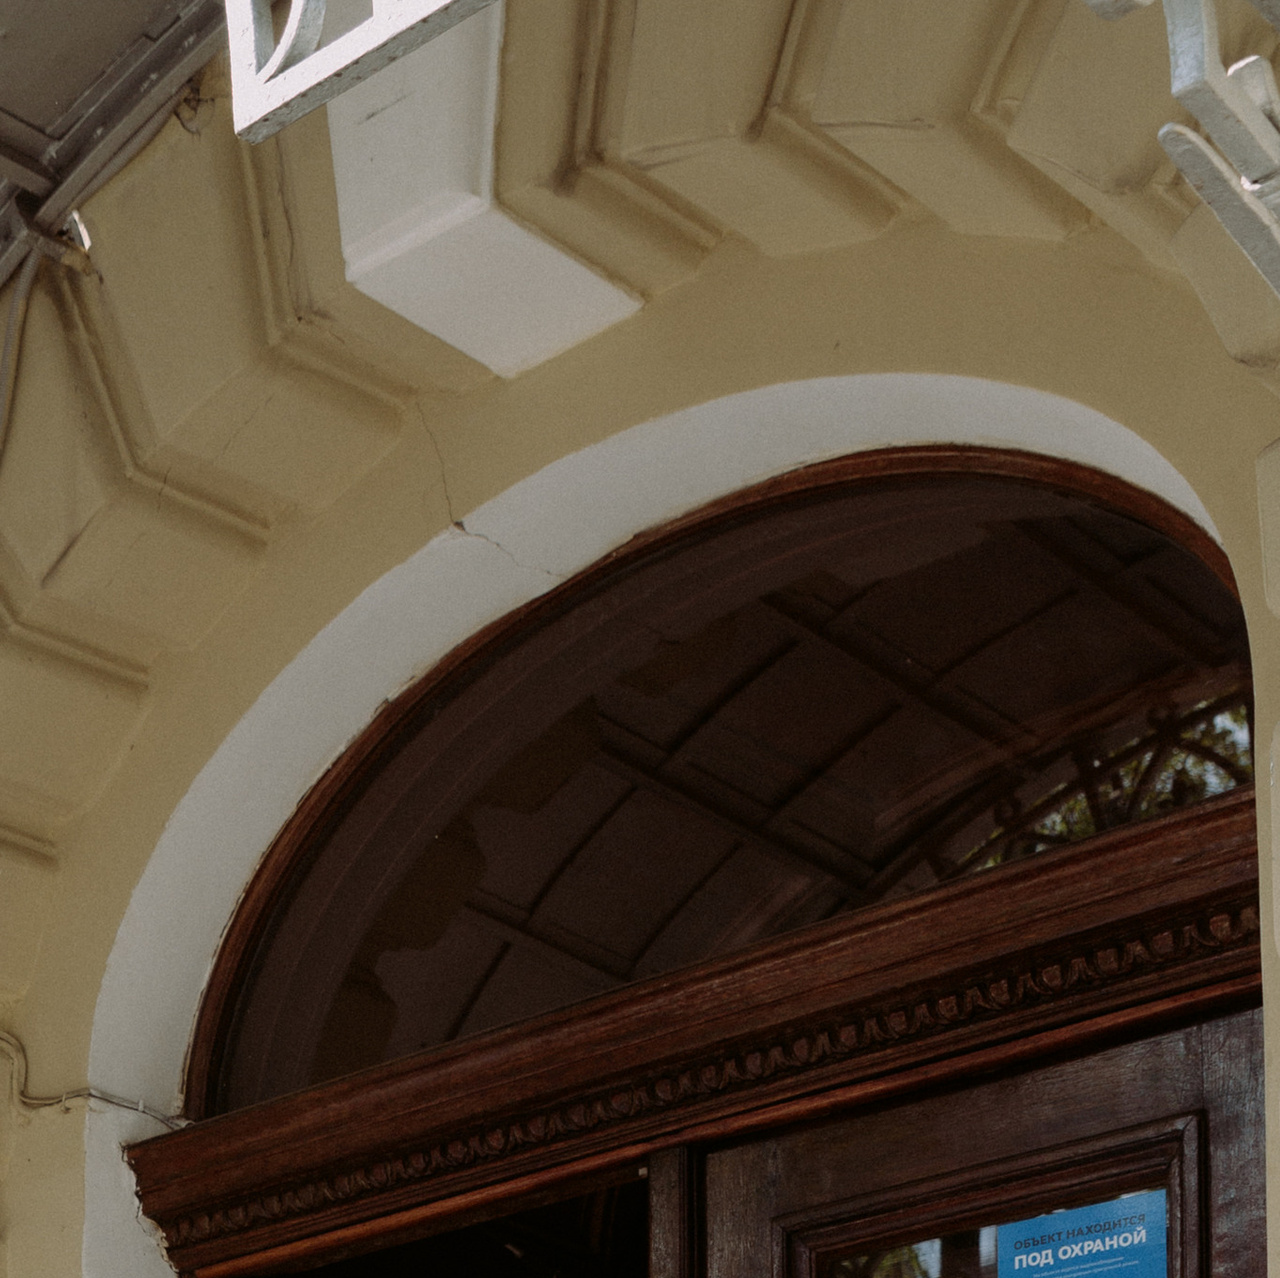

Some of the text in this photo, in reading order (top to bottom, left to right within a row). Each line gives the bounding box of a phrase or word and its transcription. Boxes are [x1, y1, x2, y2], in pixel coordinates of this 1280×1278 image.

[1014, 1213, 1145, 1250] ОБЪЕКТ НАХОДИТСЯ
[1014, 1249, 1054, 1270] ПОД
[1058, 1226, 1147, 1260] ОХРАНОЙ
